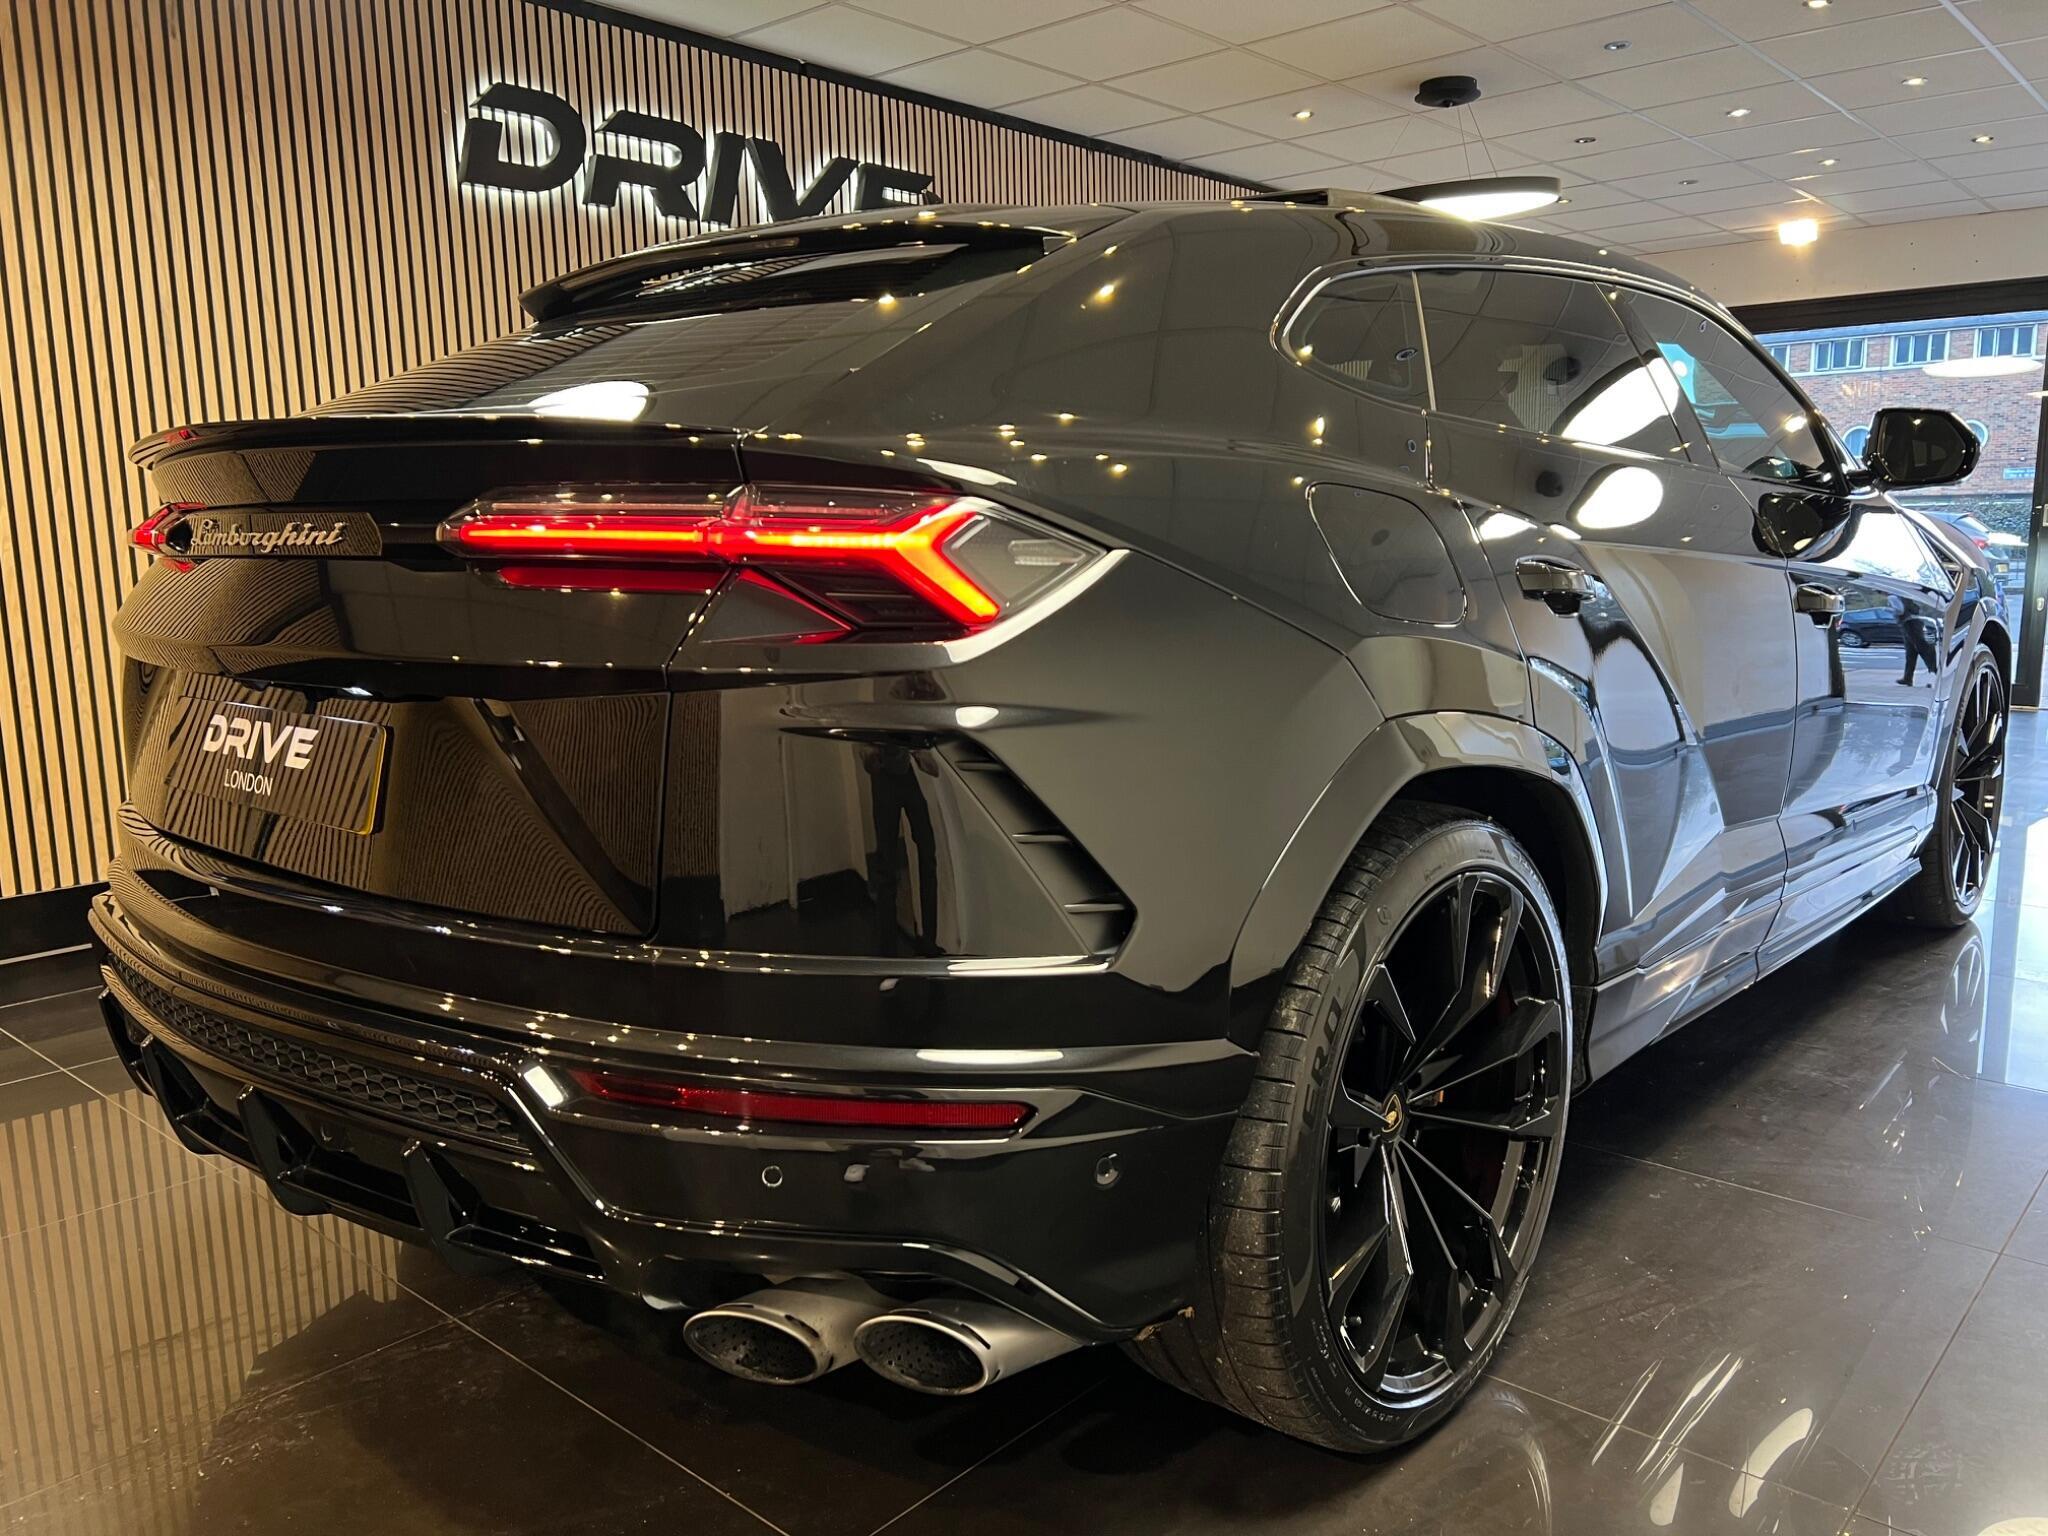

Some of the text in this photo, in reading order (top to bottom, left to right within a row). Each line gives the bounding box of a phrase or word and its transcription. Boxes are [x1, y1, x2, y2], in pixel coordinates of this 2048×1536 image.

[459, 81, 936, 224] DRIVE
[190, 518, 347, 553] Lamborghini
[203, 714, 319, 770] DRIVE
[224, 769, 273, 797] LONDON
